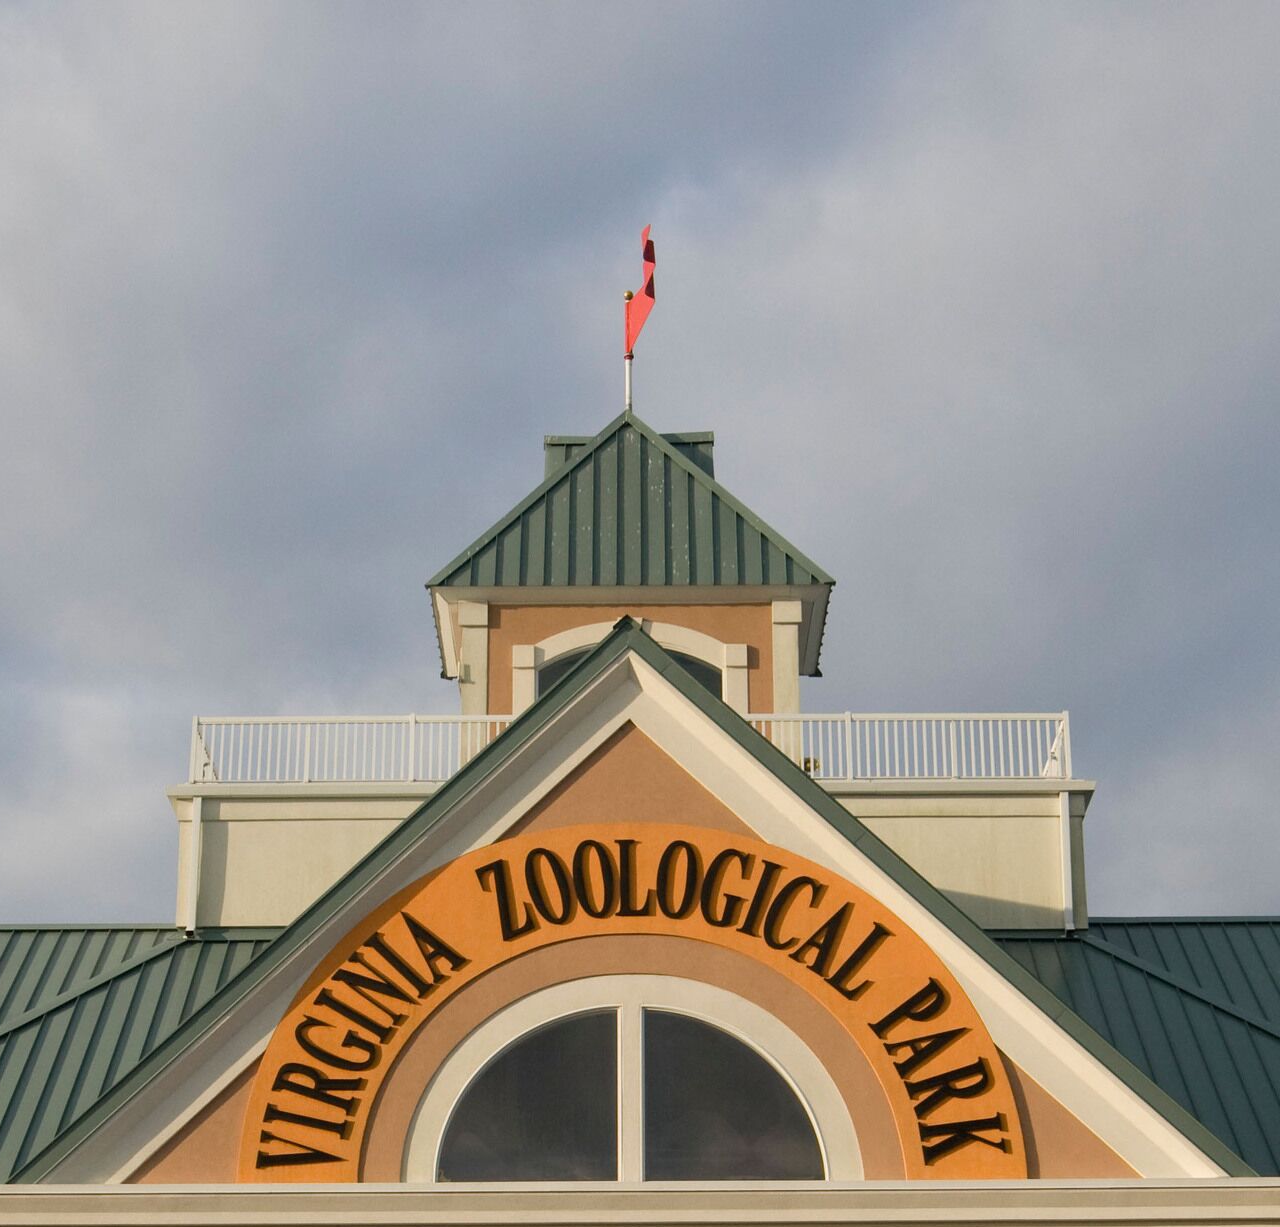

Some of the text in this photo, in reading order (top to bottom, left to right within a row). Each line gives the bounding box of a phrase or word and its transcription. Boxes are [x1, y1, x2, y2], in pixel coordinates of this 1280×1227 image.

[256, 839, 1014, 1170] VIRGINIA ZOOLOGICAL PARK
